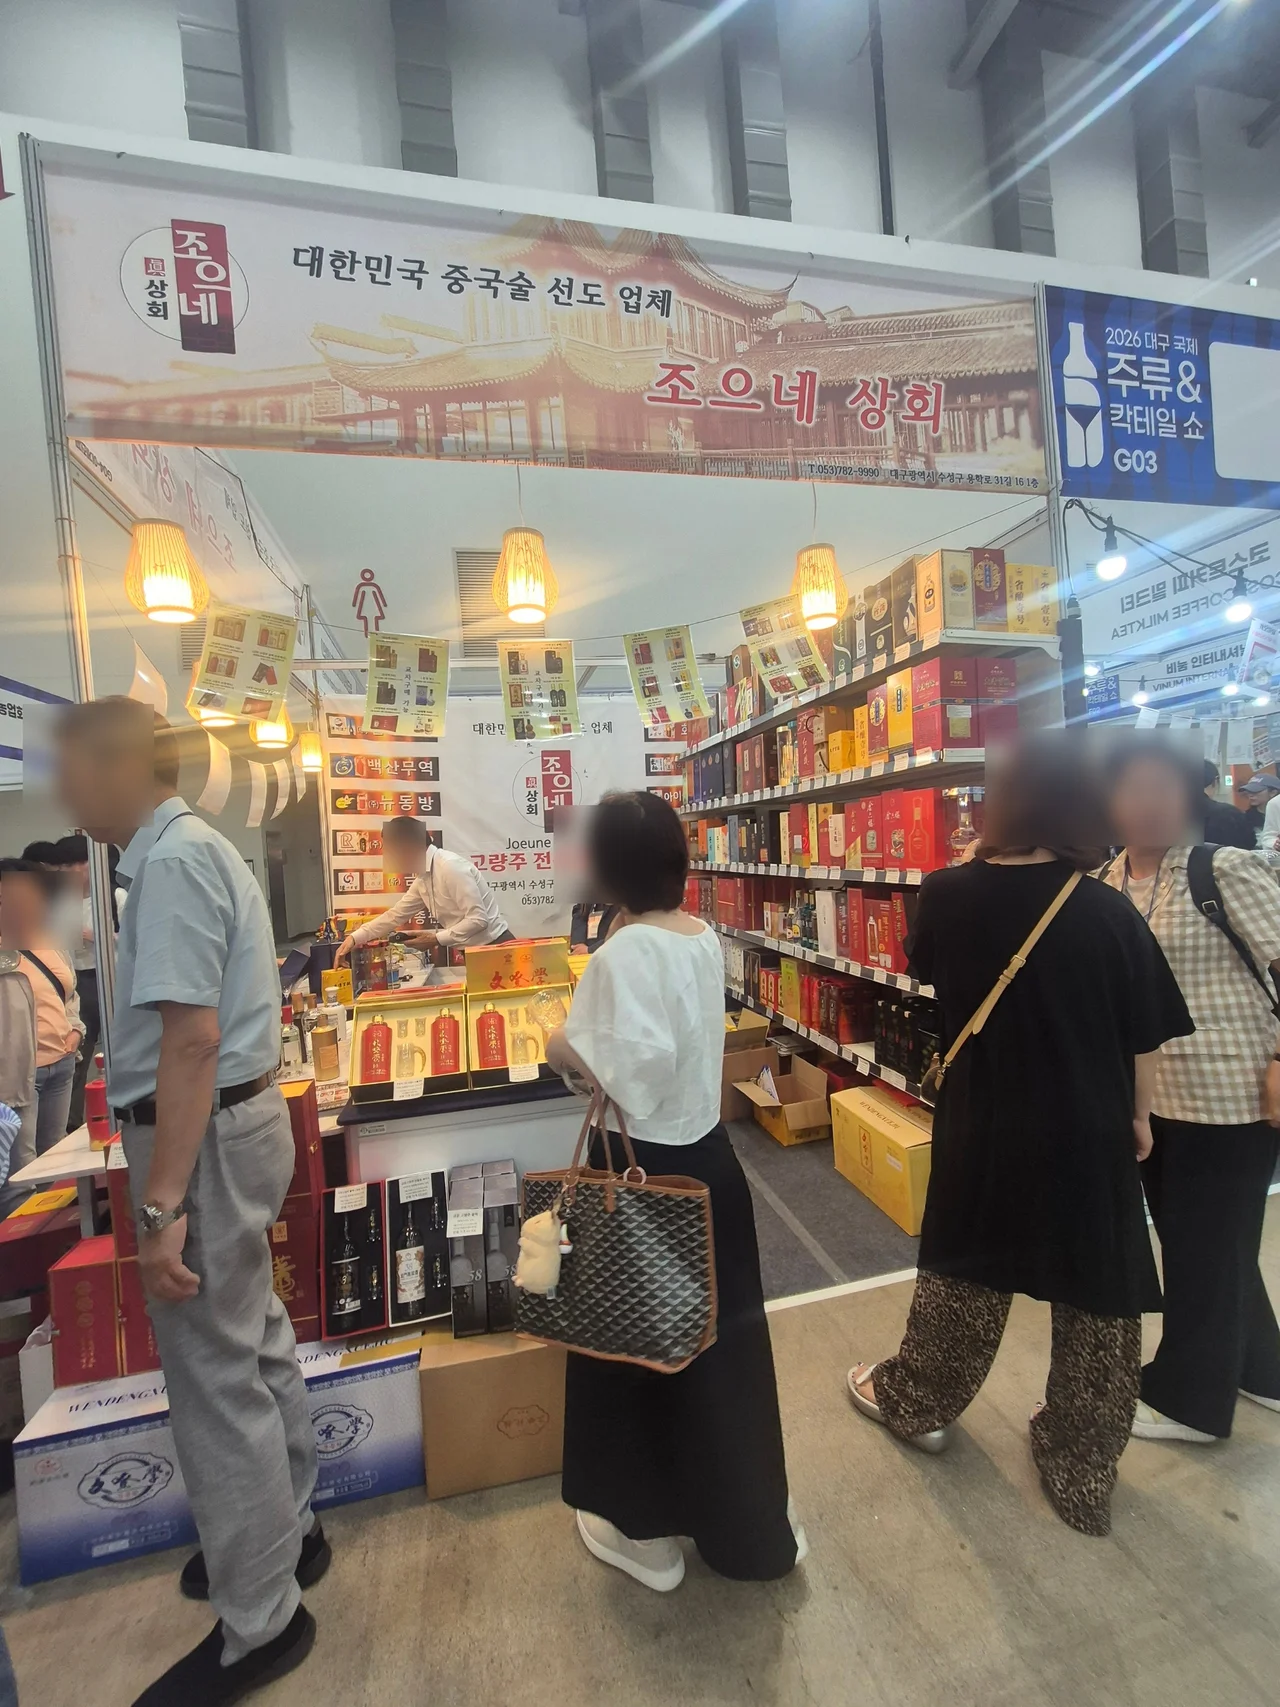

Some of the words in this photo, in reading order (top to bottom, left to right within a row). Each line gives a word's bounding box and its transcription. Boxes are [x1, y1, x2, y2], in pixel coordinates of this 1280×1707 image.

[174, 229, 231, 326] 조으네
[292, 244, 428, 290] 대한민국
[440, 263, 537, 302] 중국술
[547, 275, 606, 308] 선도
[618, 285, 674, 319] 업체
[145, 279, 169, 320] 상회
[1105, 327, 1142, 348] 2026
[1144, 332, 1170, 352] 대구
[1173, 335, 1199, 356] 국제
[647, 362, 819, 425] 조으네
[849, 376, 944, 434] 상회
[1109, 403, 1178, 439] 칵테일
[1183, 411, 1205, 440] 쇼
[1113, 448, 1158, 474] G03
[890, 469, 935, 482] 대구광역시
[937, 472, 964, 483] 수성구
[966, 473, 992, 485] 용학로
[993, 475, 1012, 486] 31길
[1015, 476, 1025, 486] 16
[1026, 477, 1039, 488] 1층
[590, 721, 613, 734] 업체
[367, 758, 433, 777] 백산무역
[526, 790, 538, 816] 상회
[505, 837, 551, 850] Joeune
[470, 853, 528, 872] 고량주
[528, 878, 555, 890] 수성구
[469, 1269, 483, 1282] 58
[504, 1264, 517, 1277] 58
